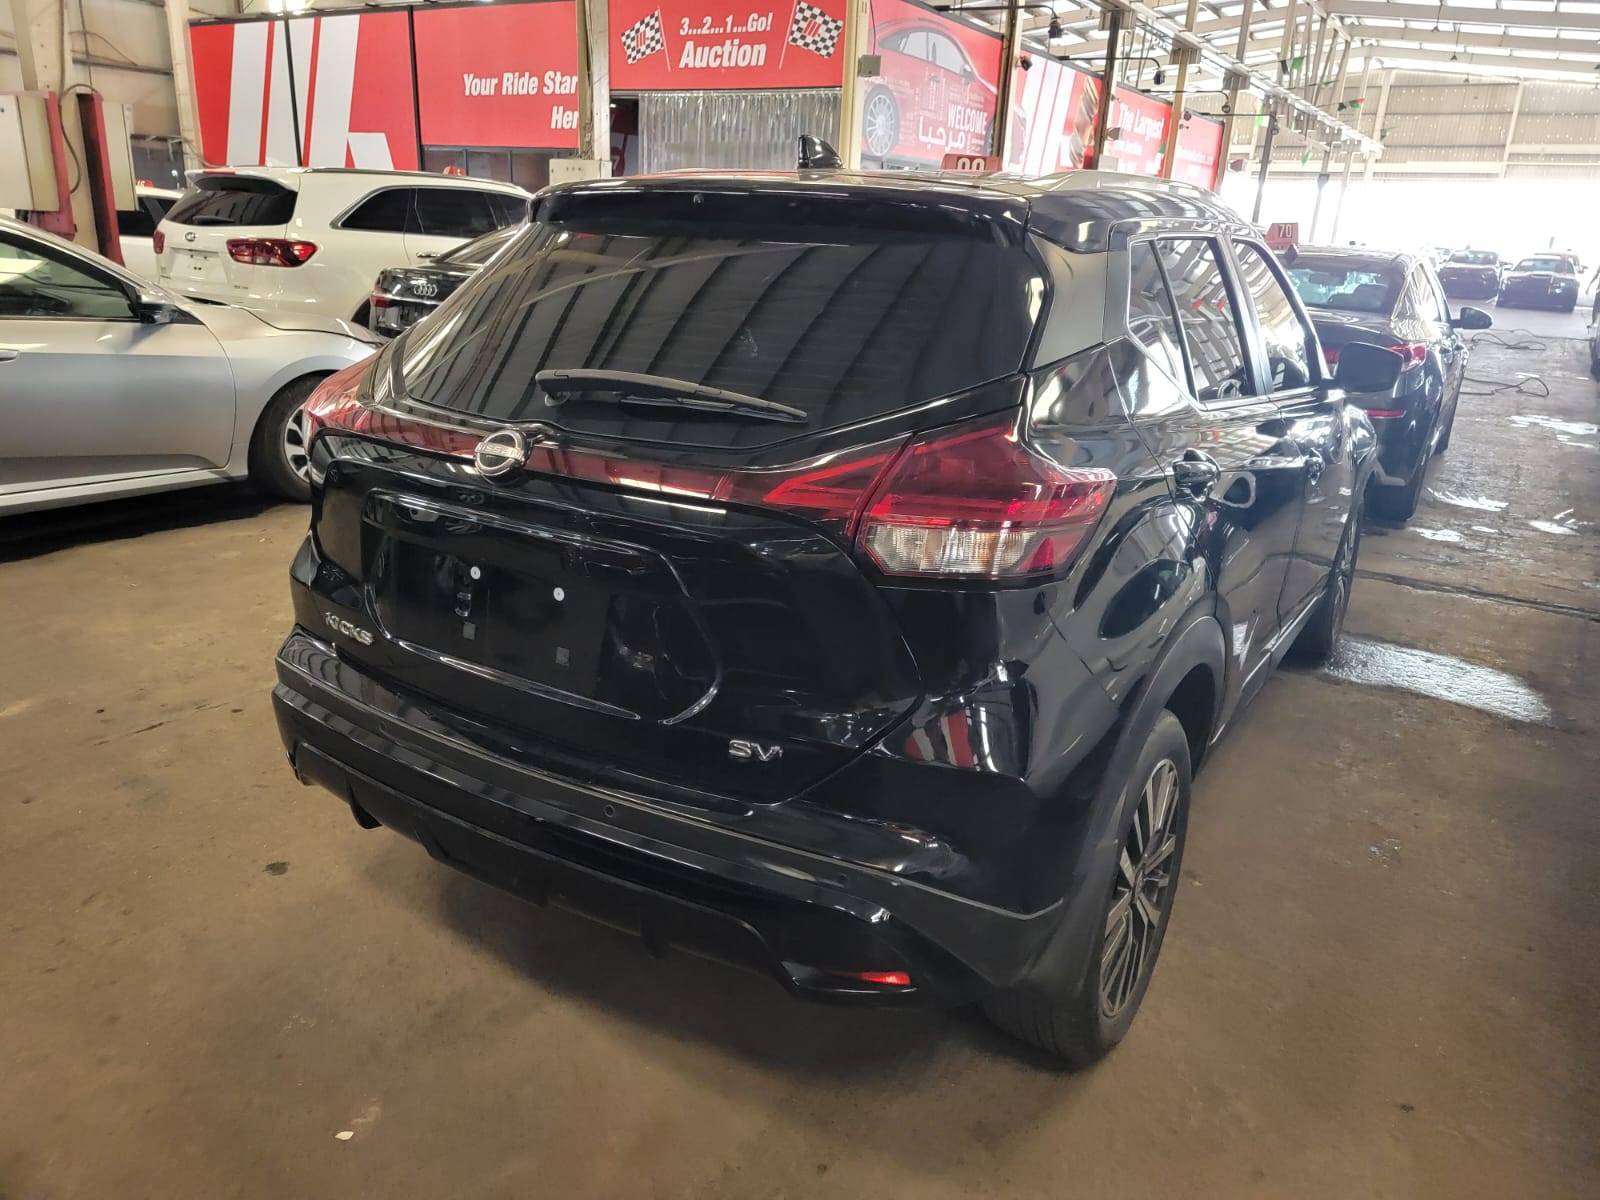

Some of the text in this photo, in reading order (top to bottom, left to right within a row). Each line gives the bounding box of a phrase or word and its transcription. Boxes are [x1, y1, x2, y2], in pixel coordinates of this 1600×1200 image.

[678, 38, 767, 68] Auction
[463, 70, 578, 96] Your Ride Star
[551, 105, 579, 129] Her
[947, 103, 988, 135] WELCOME
[1118, 102, 1136, 131] The
[918, 115, 966, 152] مرحبا
[1279, 223, 1293, 238] 70
[325, 611, 373, 646] KICKS
[728, 739, 782, 762] SV
